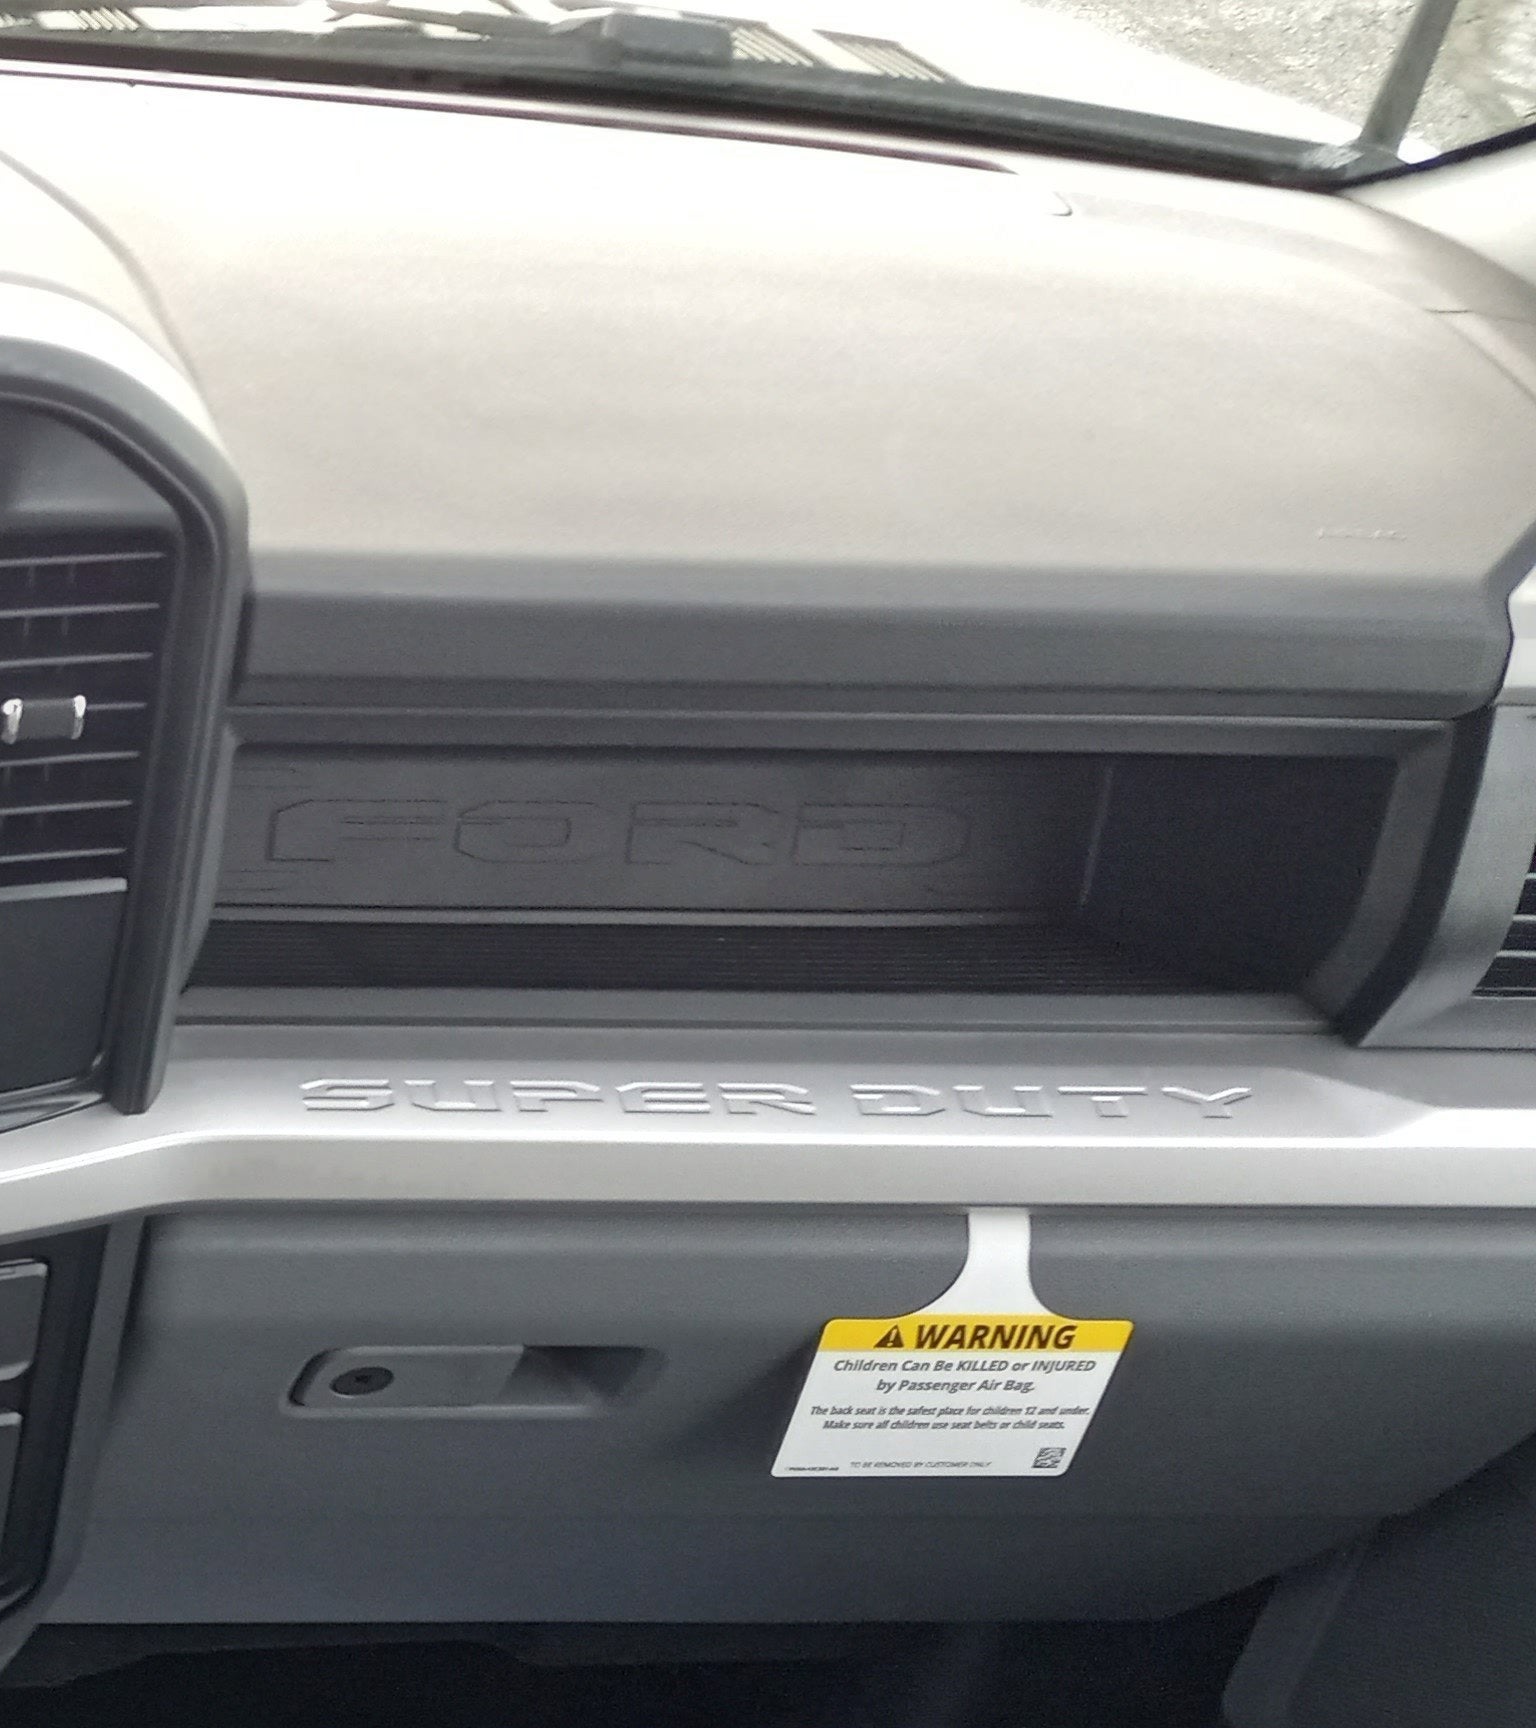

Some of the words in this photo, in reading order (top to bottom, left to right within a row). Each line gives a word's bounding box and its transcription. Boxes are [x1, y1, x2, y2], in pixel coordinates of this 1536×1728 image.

[266, 800, 972, 866] FORD
[298, 1078, 818, 1117] SUPER
[851, 1084, 1252, 1120] DUTY
[914, 1325, 1077, 1349] WARNING
[833, 1360, 897, 1371] Children
[901, 1360, 929, 1371] Can
[933, 1360, 953, 1371] Be
[956, 1361, 1008, 1371] KILLED
[1012, 1363, 1029, 1371] or
[1031, 1361, 1096, 1373] INJURED
[876, 1379, 896, 1393] by
[898, 1380, 976, 1393] Passenger
[977, 1380, 1001, 1391] Air
[1003, 1380, 1035, 1393] Bag.
[811, 1406, 828, 1415] The
[830, 1406, 852, 1415] back
[855, 1407, 876, 1415] seat
[878, 1407, 887, 1415] is
[889, 1406, 905, 1415] the
[907, 1406, 935, 1415] safest
[937, 1407, 962, 1417] place
[966, 1406, 980, 1415] for
[982, 1406, 1022, 1415] children
[1038, 1406, 1057, 1415] and
[823, 1420, 850, 1429] Make
[950, 1421, 971, 1429] seat
[973, 1420, 997, 1429] belts
